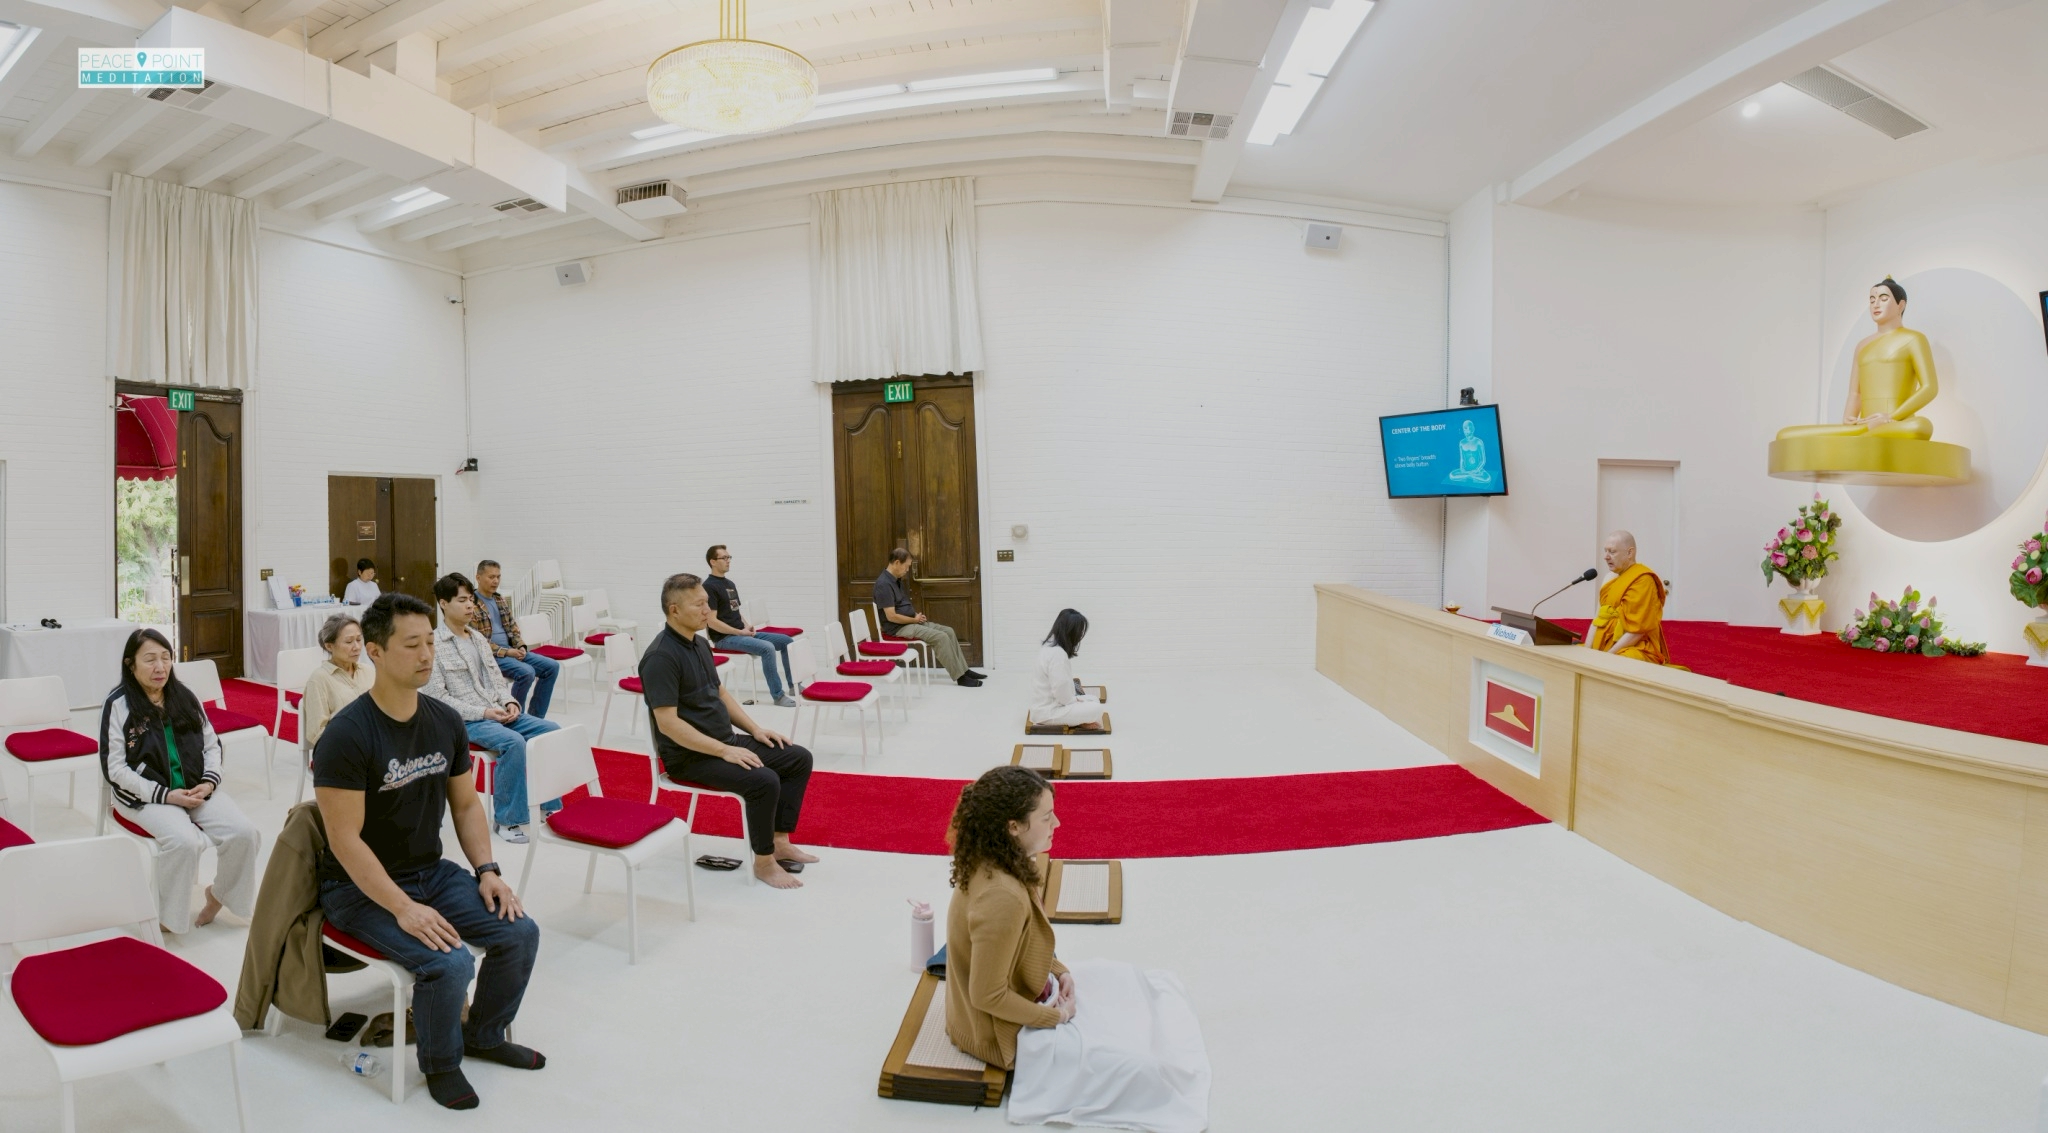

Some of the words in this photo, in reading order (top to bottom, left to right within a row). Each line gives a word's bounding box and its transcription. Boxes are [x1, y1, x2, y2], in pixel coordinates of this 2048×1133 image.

[172, 391, 192, 409] EXIT
[888, 384, 910, 400] EXIT
[1391, 427, 1411, 435] CENTER
[1431, 423, 1446, 431] BODY
[383, 752, 445, 784] Science
